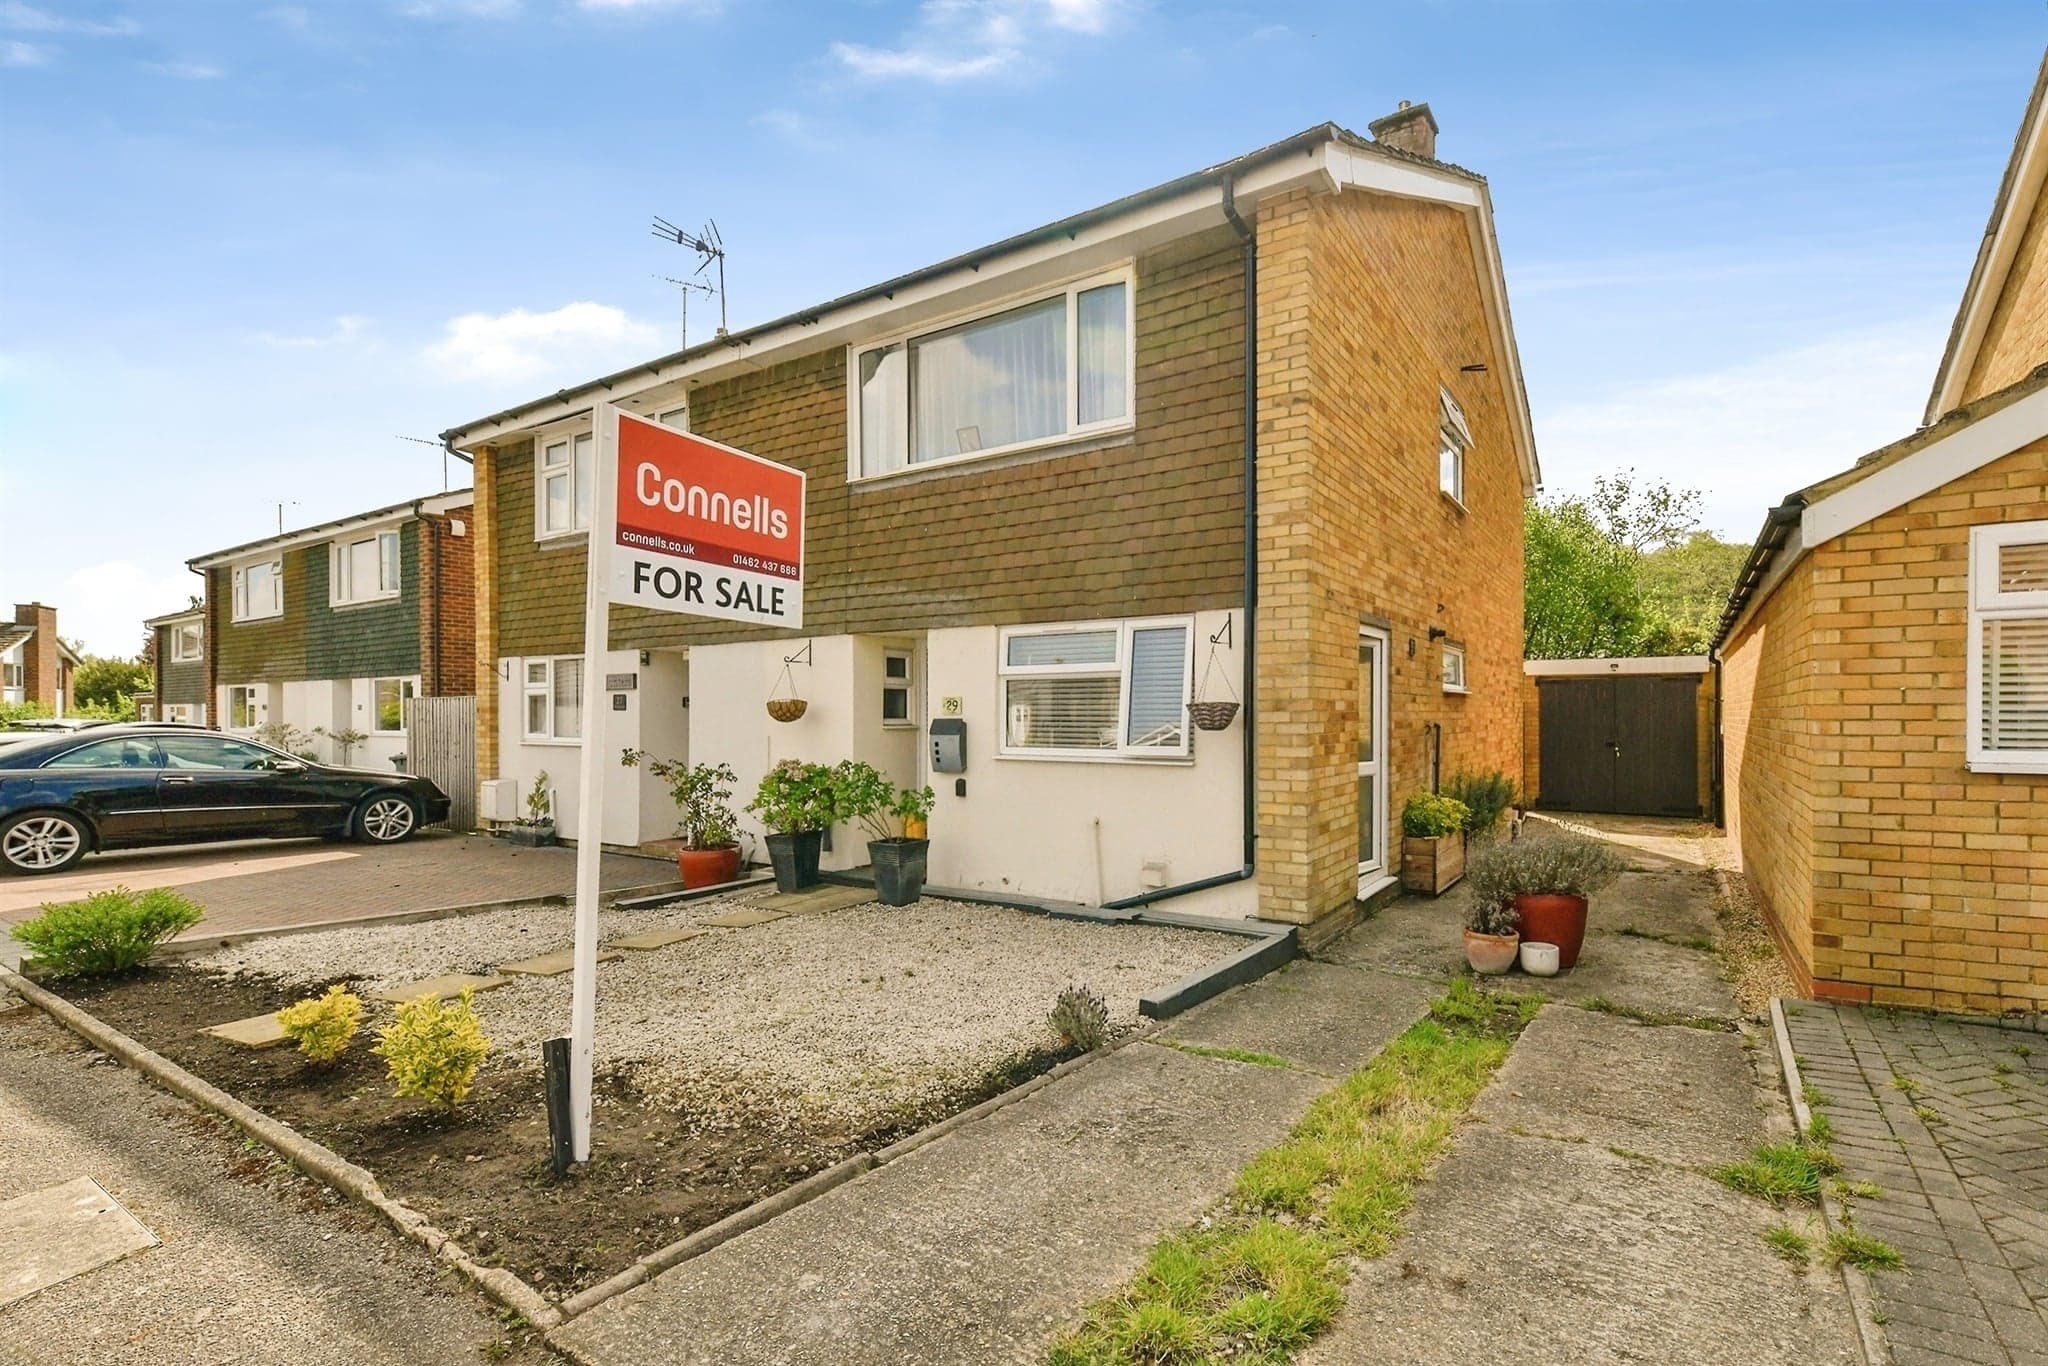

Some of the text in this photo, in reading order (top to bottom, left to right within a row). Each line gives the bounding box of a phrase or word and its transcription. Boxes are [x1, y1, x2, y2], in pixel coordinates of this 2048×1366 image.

[636, 461, 788, 539] Connells
[622, 531, 695, 555] connells.co.uk
[732, 553, 760, 569] 01462
[762, 560, 778, 572] 437
[633, 561, 784, 616] FOR SALE
[946, 700, 958, 712] 29
